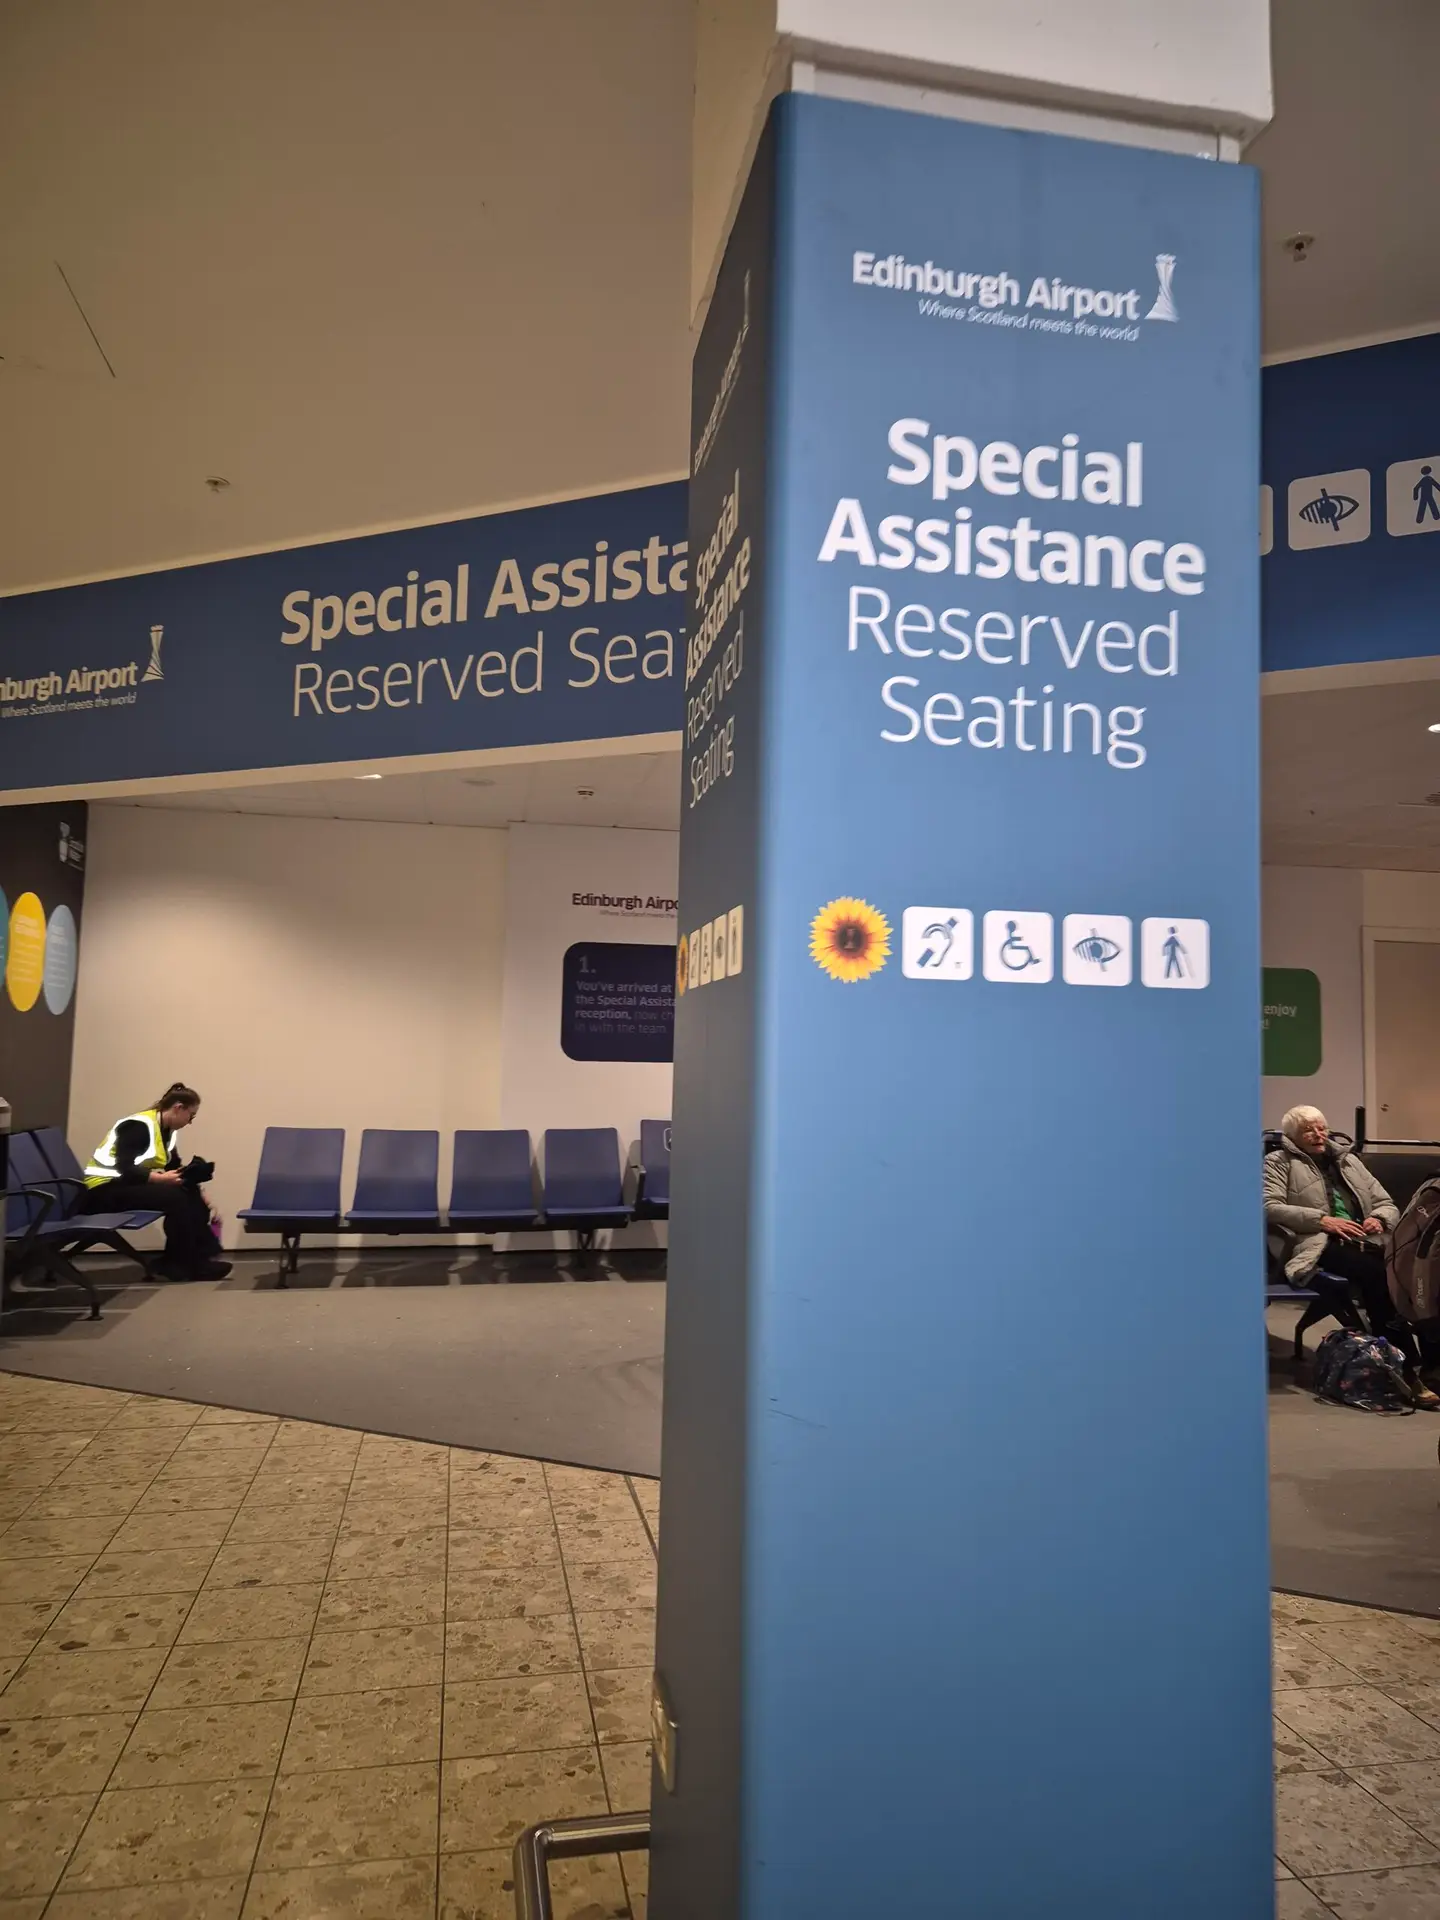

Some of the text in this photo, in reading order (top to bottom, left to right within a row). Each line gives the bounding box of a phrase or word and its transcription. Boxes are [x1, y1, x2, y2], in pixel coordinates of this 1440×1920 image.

[853, 250, 1141, 320] Edinburgh Airport
[918, 299, 1140, 341] Where Scotland meets the world
[886, 417, 1144, 507] Special
[695, 468, 739, 610] Special
[817, 497, 1206, 595] Assistance
[281, 563, 470, 651] Special
[685, 536, 751, 692] Assistance
[848, 586, 1179, 676] Reserved
[65, 661, 138, 694] Airport
[293, 632, 543, 717] Reserved
[687, 609, 745, 749] Reserved
[690, 714, 736, 809] Seating
[880, 676, 1147, 769] Seating
[572, 893, 642, 910] Edinburgh
[575, 994, 595, 1006] the
[597, 995, 636, 1007] Special
[576, 980, 672, 993] You've arrived at
[579, 955, 596, 973] 1.
[575, 1008, 632, 1020] reception,
[1263, 1003, 1297, 1017] enjoy
